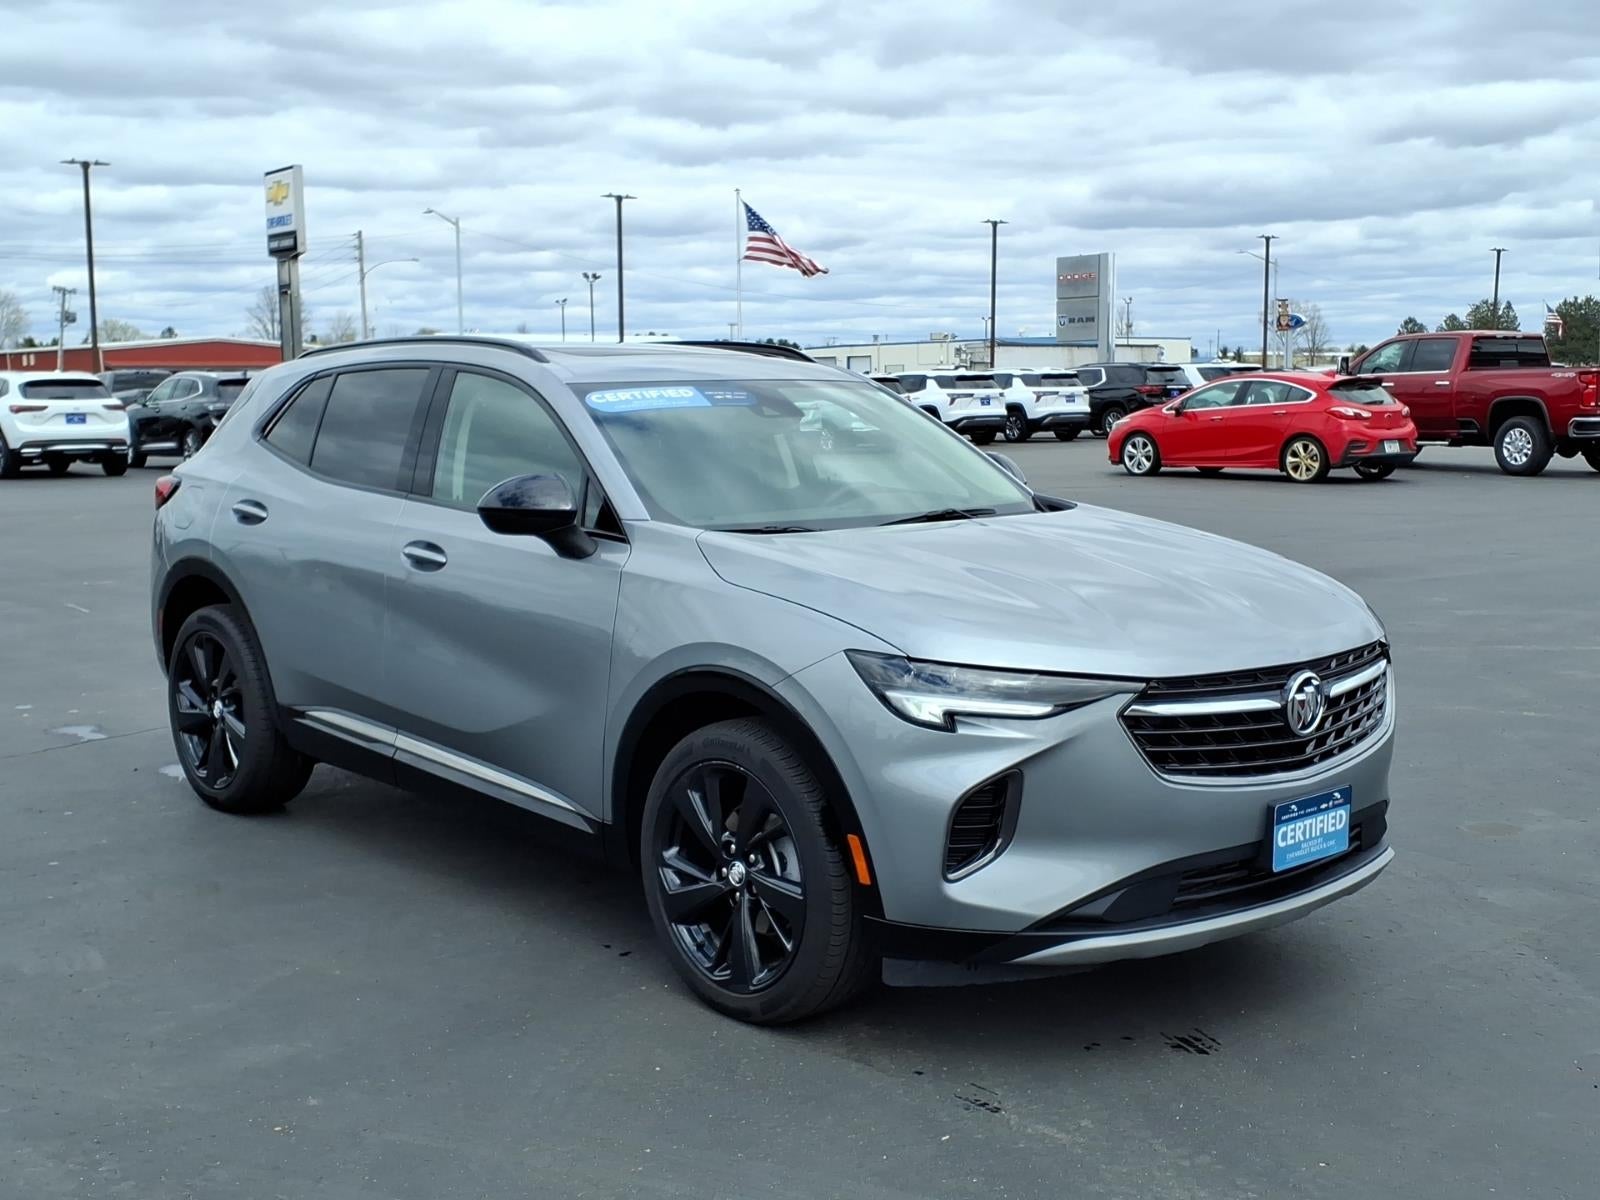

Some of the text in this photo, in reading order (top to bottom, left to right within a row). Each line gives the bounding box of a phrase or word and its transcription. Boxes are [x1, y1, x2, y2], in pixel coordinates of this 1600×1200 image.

[1068, 316, 1096, 324] RAM
[590, 388, 695, 404] CERTIFIED
[1277, 809, 1346, 847] CERTIFIED
